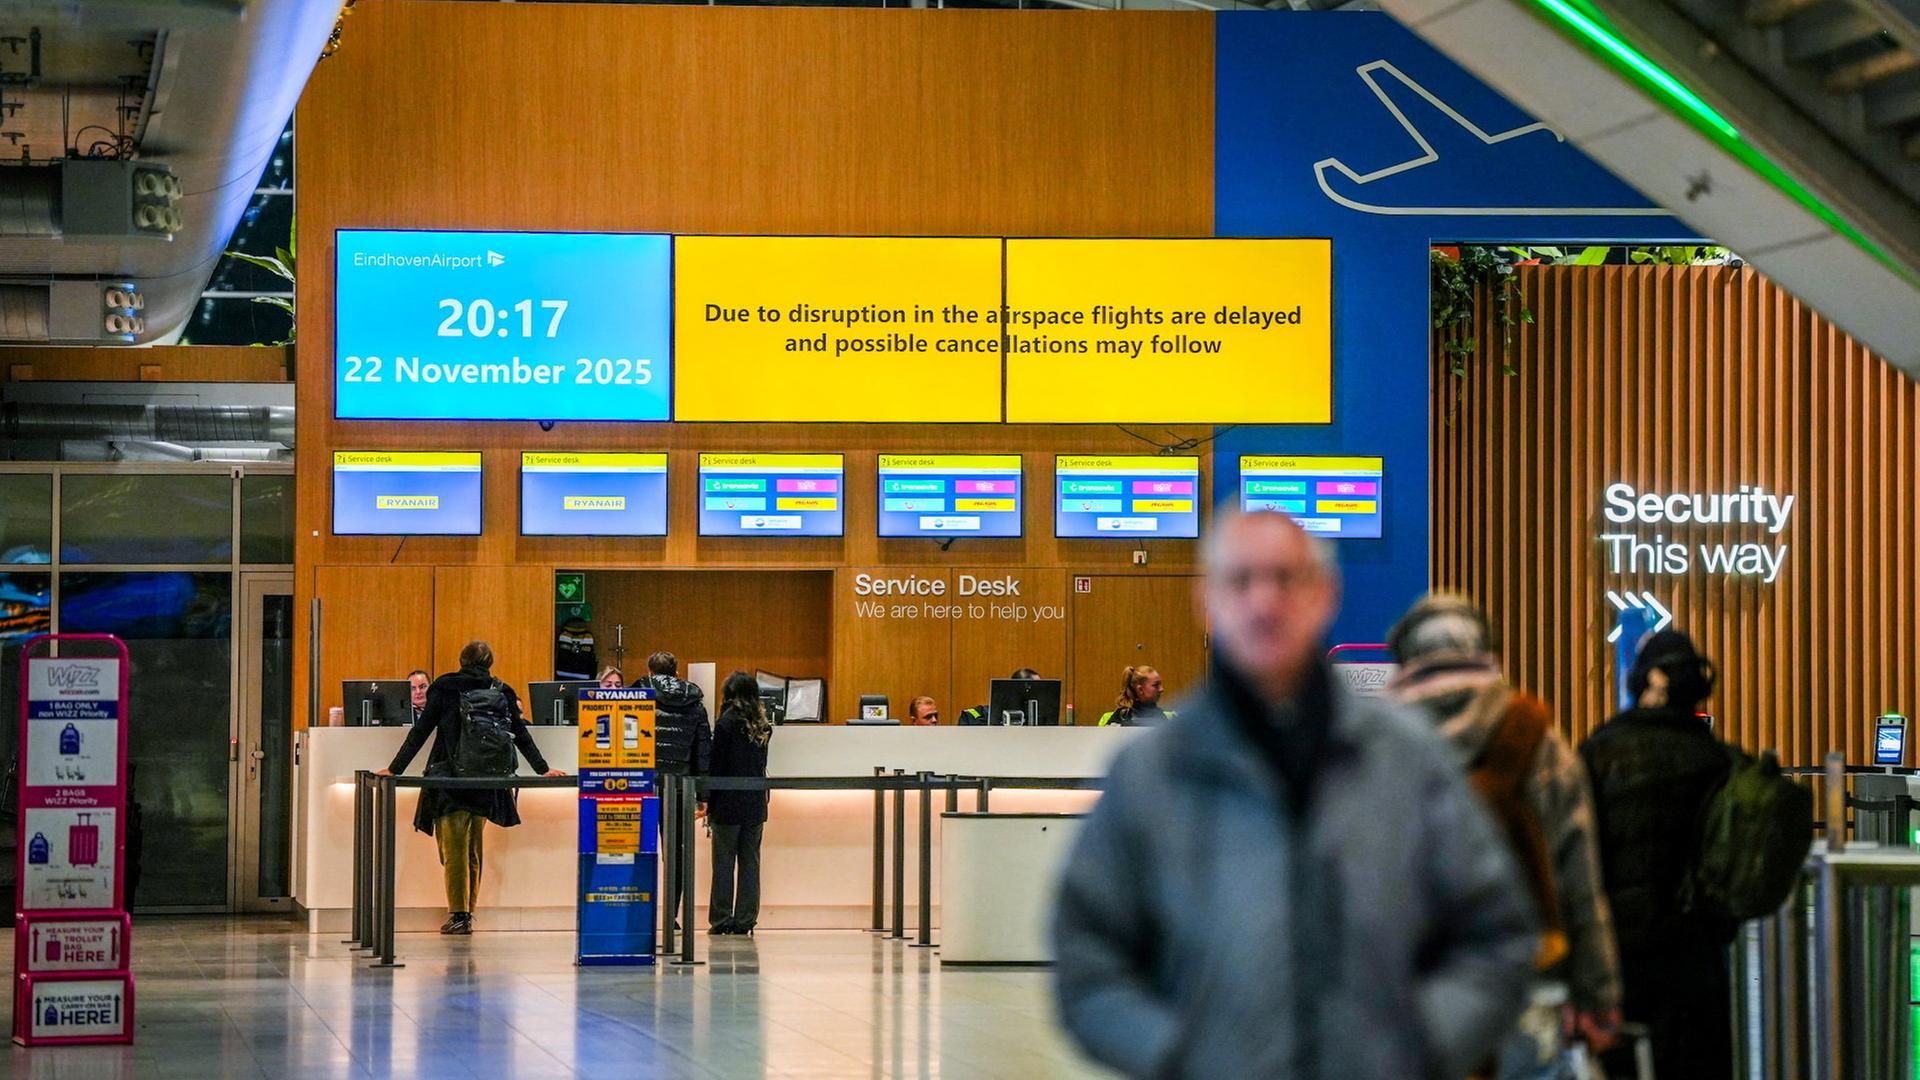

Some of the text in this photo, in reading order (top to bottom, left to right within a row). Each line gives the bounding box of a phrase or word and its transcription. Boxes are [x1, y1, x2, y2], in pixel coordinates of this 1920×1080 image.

[354, 252, 482, 270] EindhovenAirport
[437, 299, 568, 338] 20:17
[705, 304, 1302, 330] Due to disruption in the airspace flights are delayed
[785, 334, 1222, 358] and possible cancellations may follow
[344, 356, 652, 385] 22 November 2025
[1604, 483, 1794, 533] Security
[1600, 534, 1786, 584] This way
[855, 574, 1020, 596] Service Desk
[855, 602, 1064, 622] We are here to help you
[596, 691, 647, 699] RYANAIR
[80, 711, 109, 719] Priority
[64, 951, 105, 962] HERE
[61, 1010, 111, 1024] HERE
